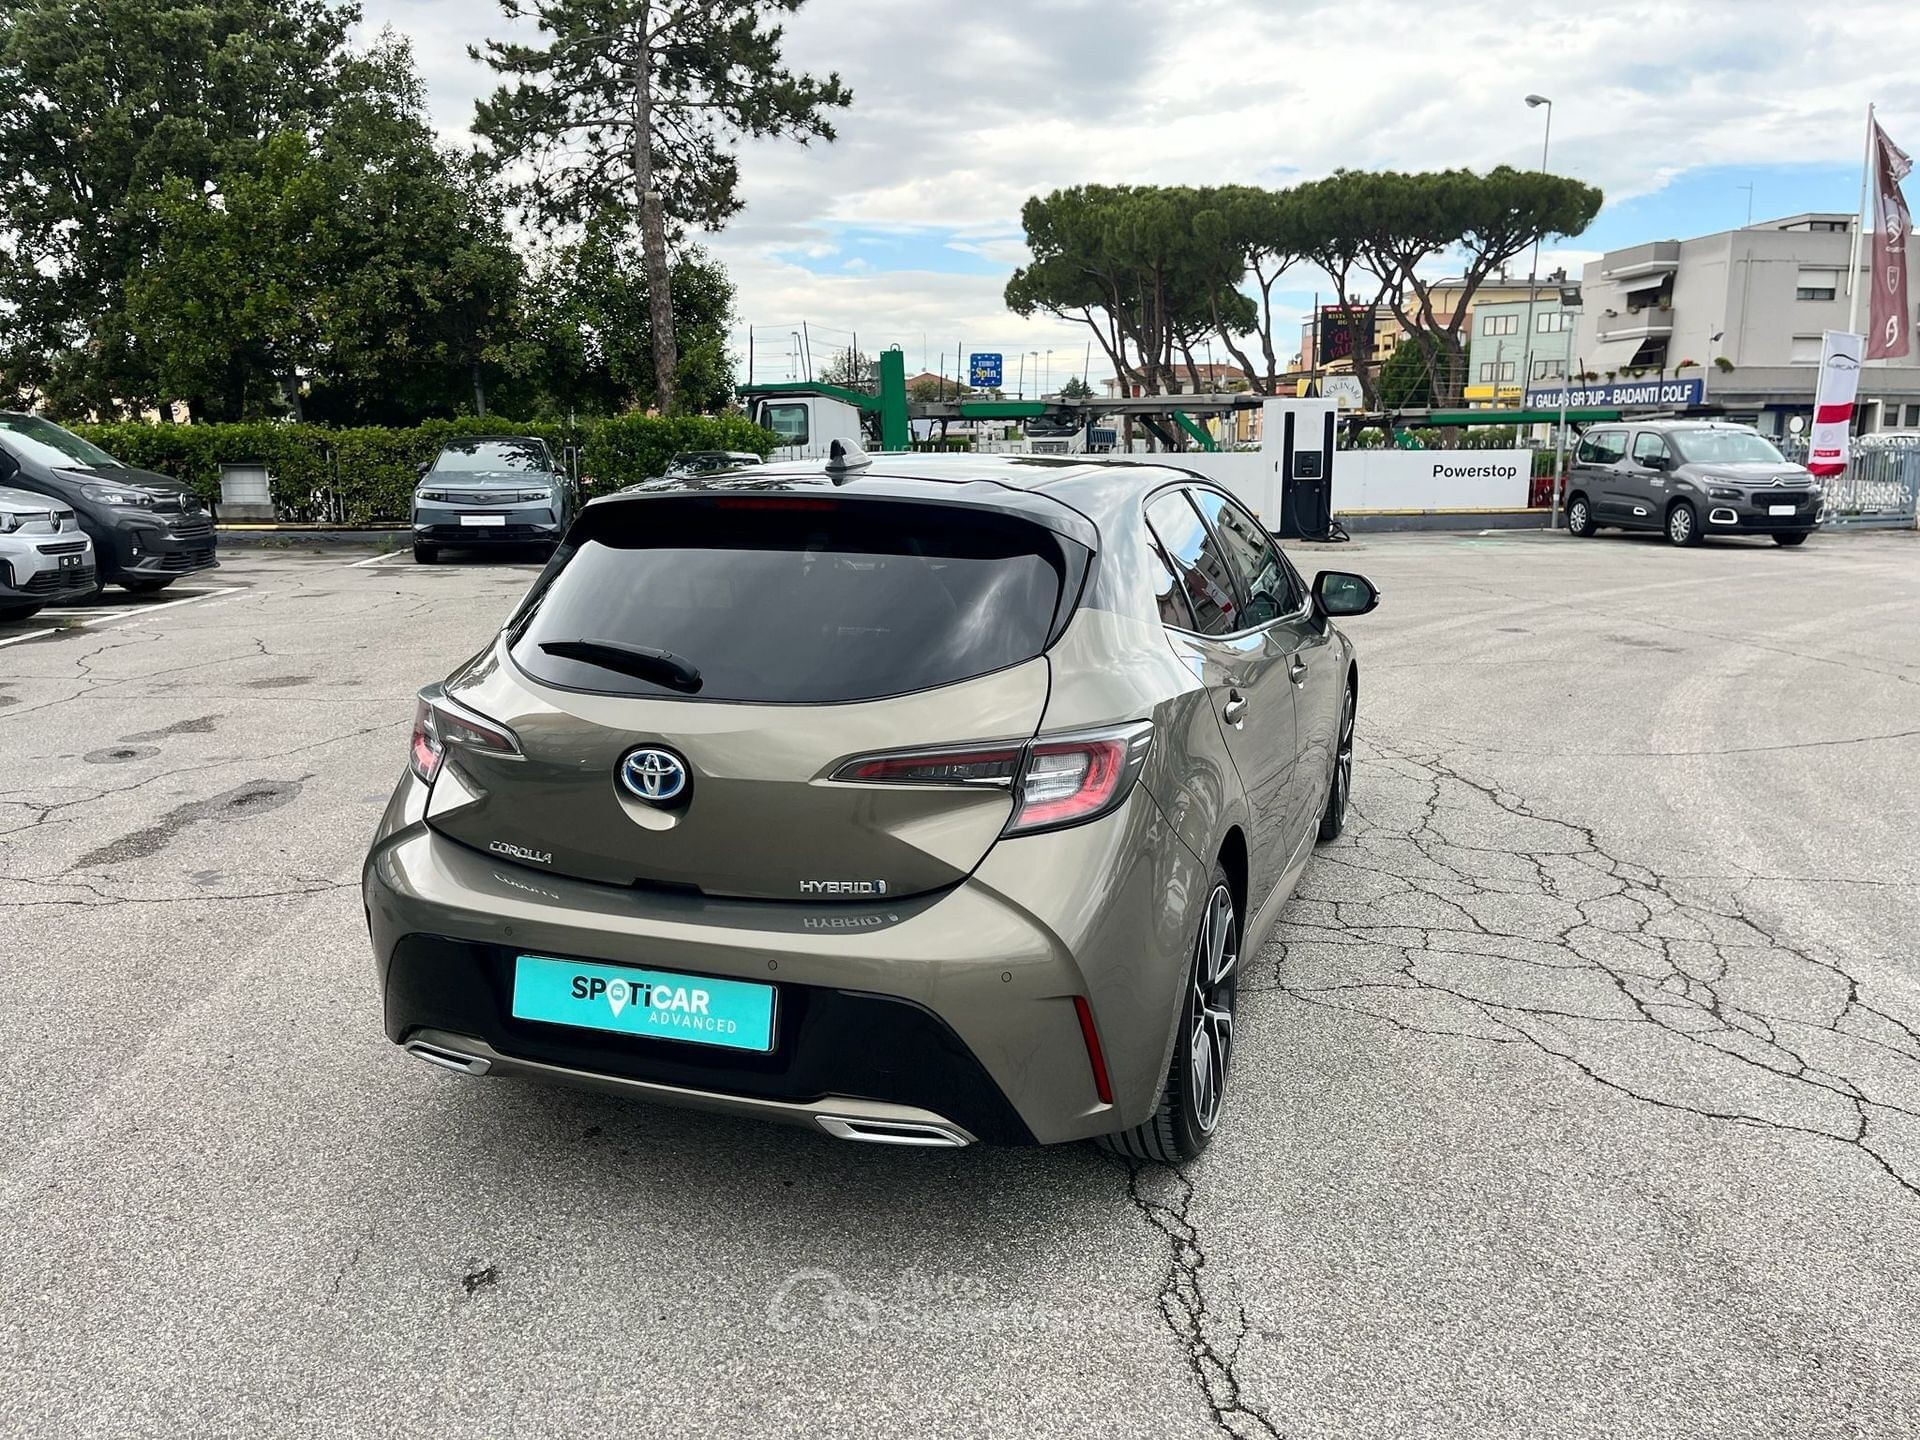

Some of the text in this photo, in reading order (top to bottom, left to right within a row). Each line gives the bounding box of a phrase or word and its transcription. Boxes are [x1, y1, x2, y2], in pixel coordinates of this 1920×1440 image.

[1571, 390, 1605, 407] GROUP
[1613, 386, 1658, 405] BADANTI
[1661, 384, 1693, 402] COLF
[1433, 464, 1517, 480] Powerstop
[489, 840, 553, 864] COROLLA
[800, 880, 873, 894] HYBRID
[649, 1010, 738, 1035] ADVANCED
